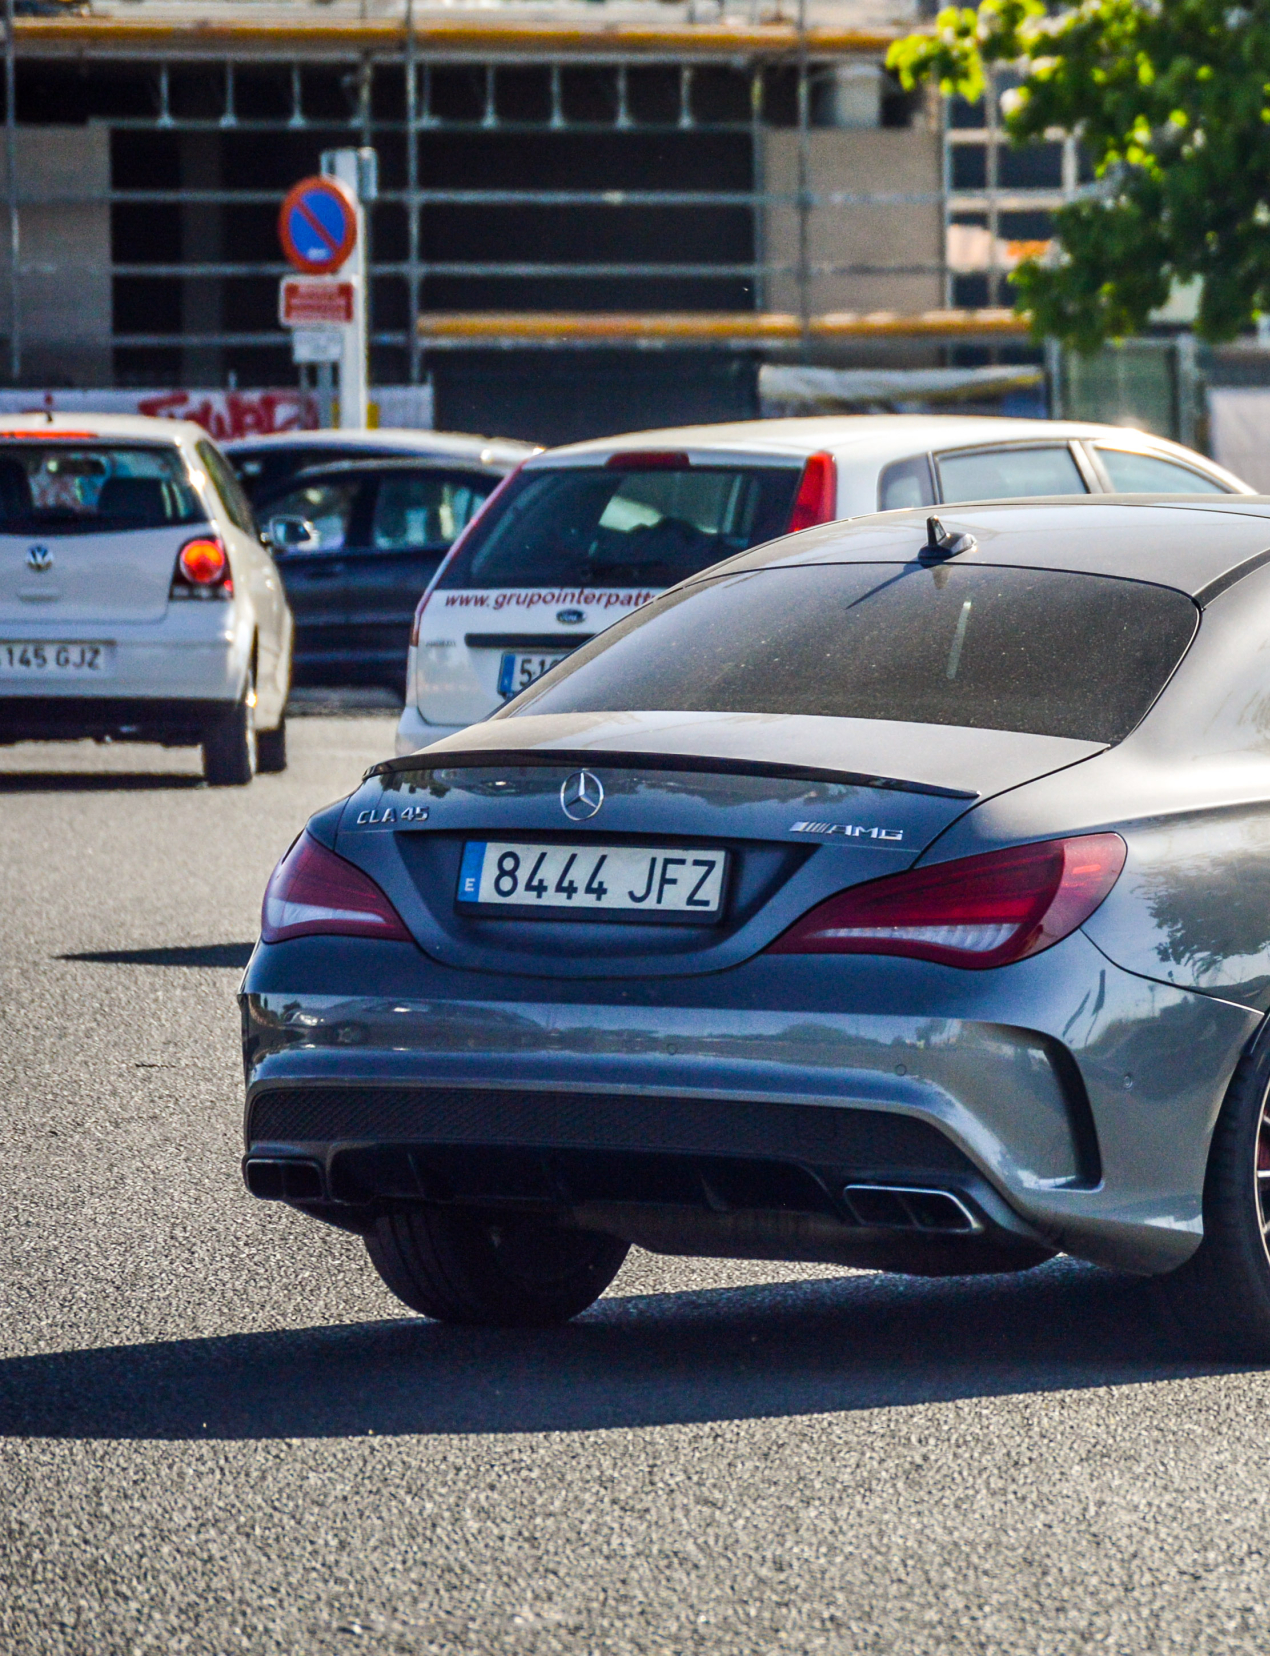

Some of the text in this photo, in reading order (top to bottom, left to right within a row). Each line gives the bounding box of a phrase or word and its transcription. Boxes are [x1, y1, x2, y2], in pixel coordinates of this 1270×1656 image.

[445, 588, 656, 609] www.grupointerpatt
[0, 646, 101, 669] 145 GJZ
[356, 806, 429, 824] CLA 45
[825, 824, 903, 840] AMG
[464, 877, 476, 892] E
[493, 851, 717, 907] 8444 JFZ
